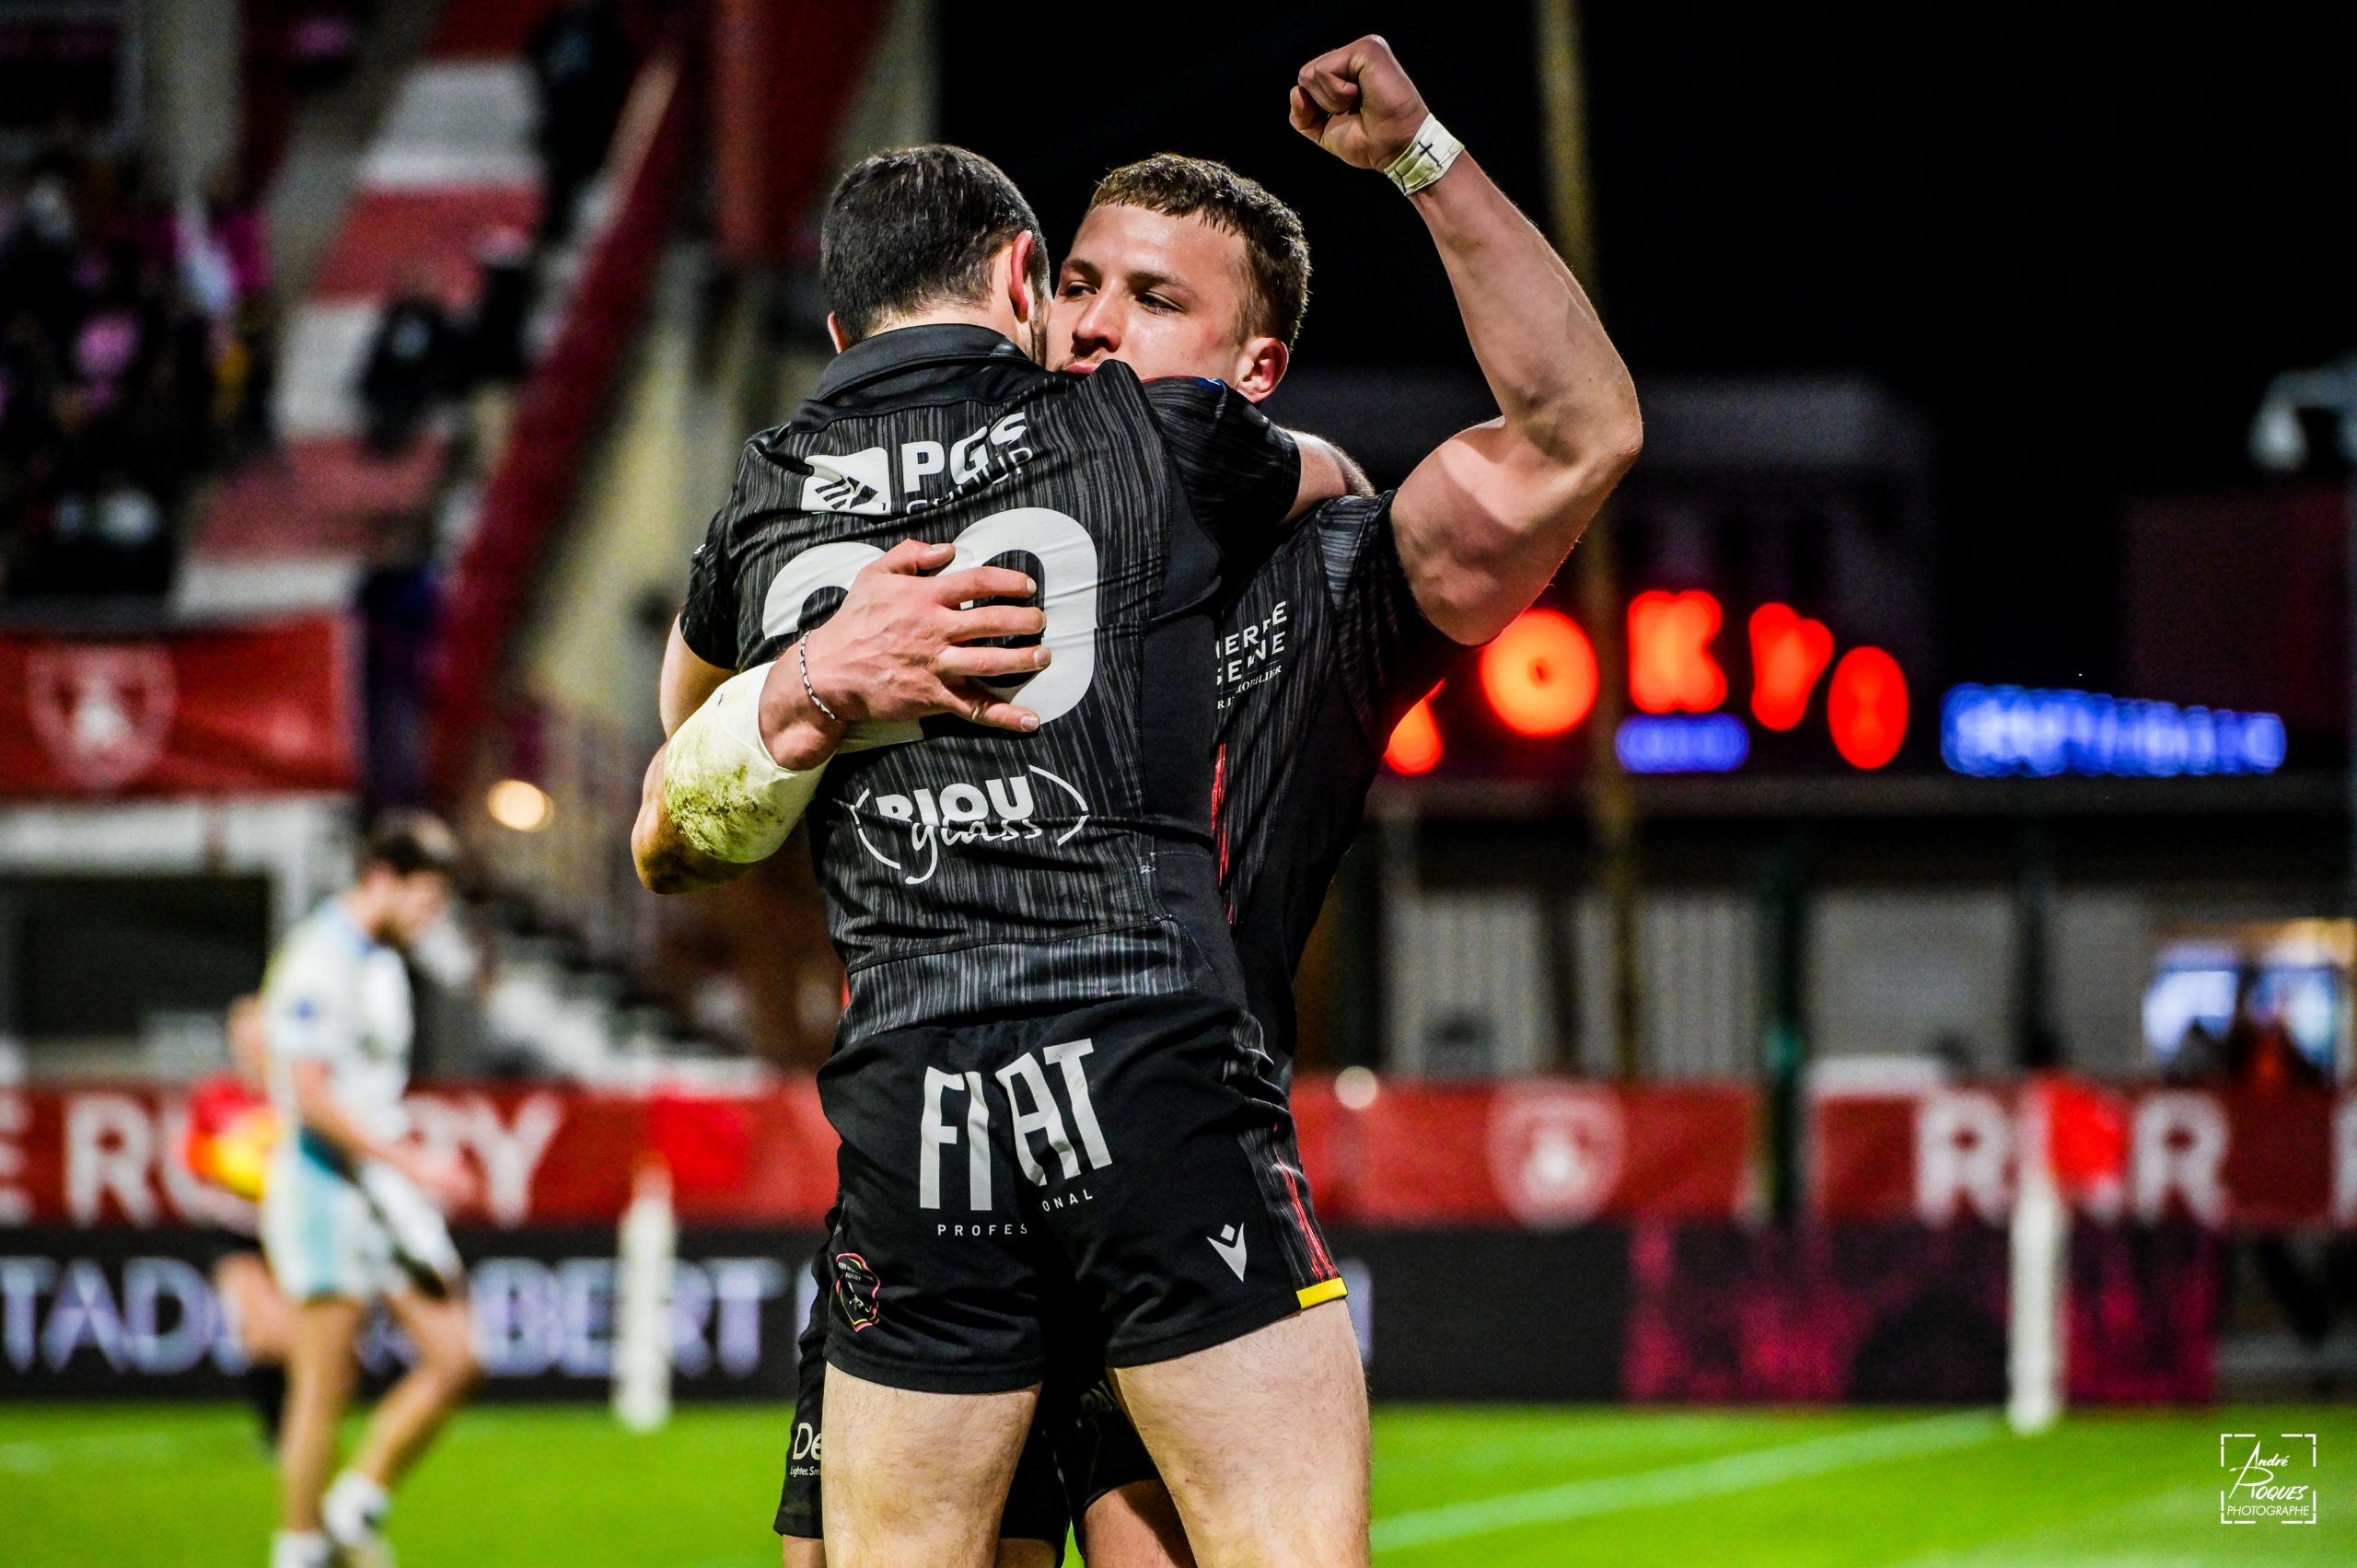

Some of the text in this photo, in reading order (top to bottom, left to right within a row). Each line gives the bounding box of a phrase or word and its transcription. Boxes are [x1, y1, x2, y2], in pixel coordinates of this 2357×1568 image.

[901, 412, 1028, 494] PGS
[920, 1038, 1113, 1211] FIAT
[937, 1189, 1094, 1237] PROFESONAL
